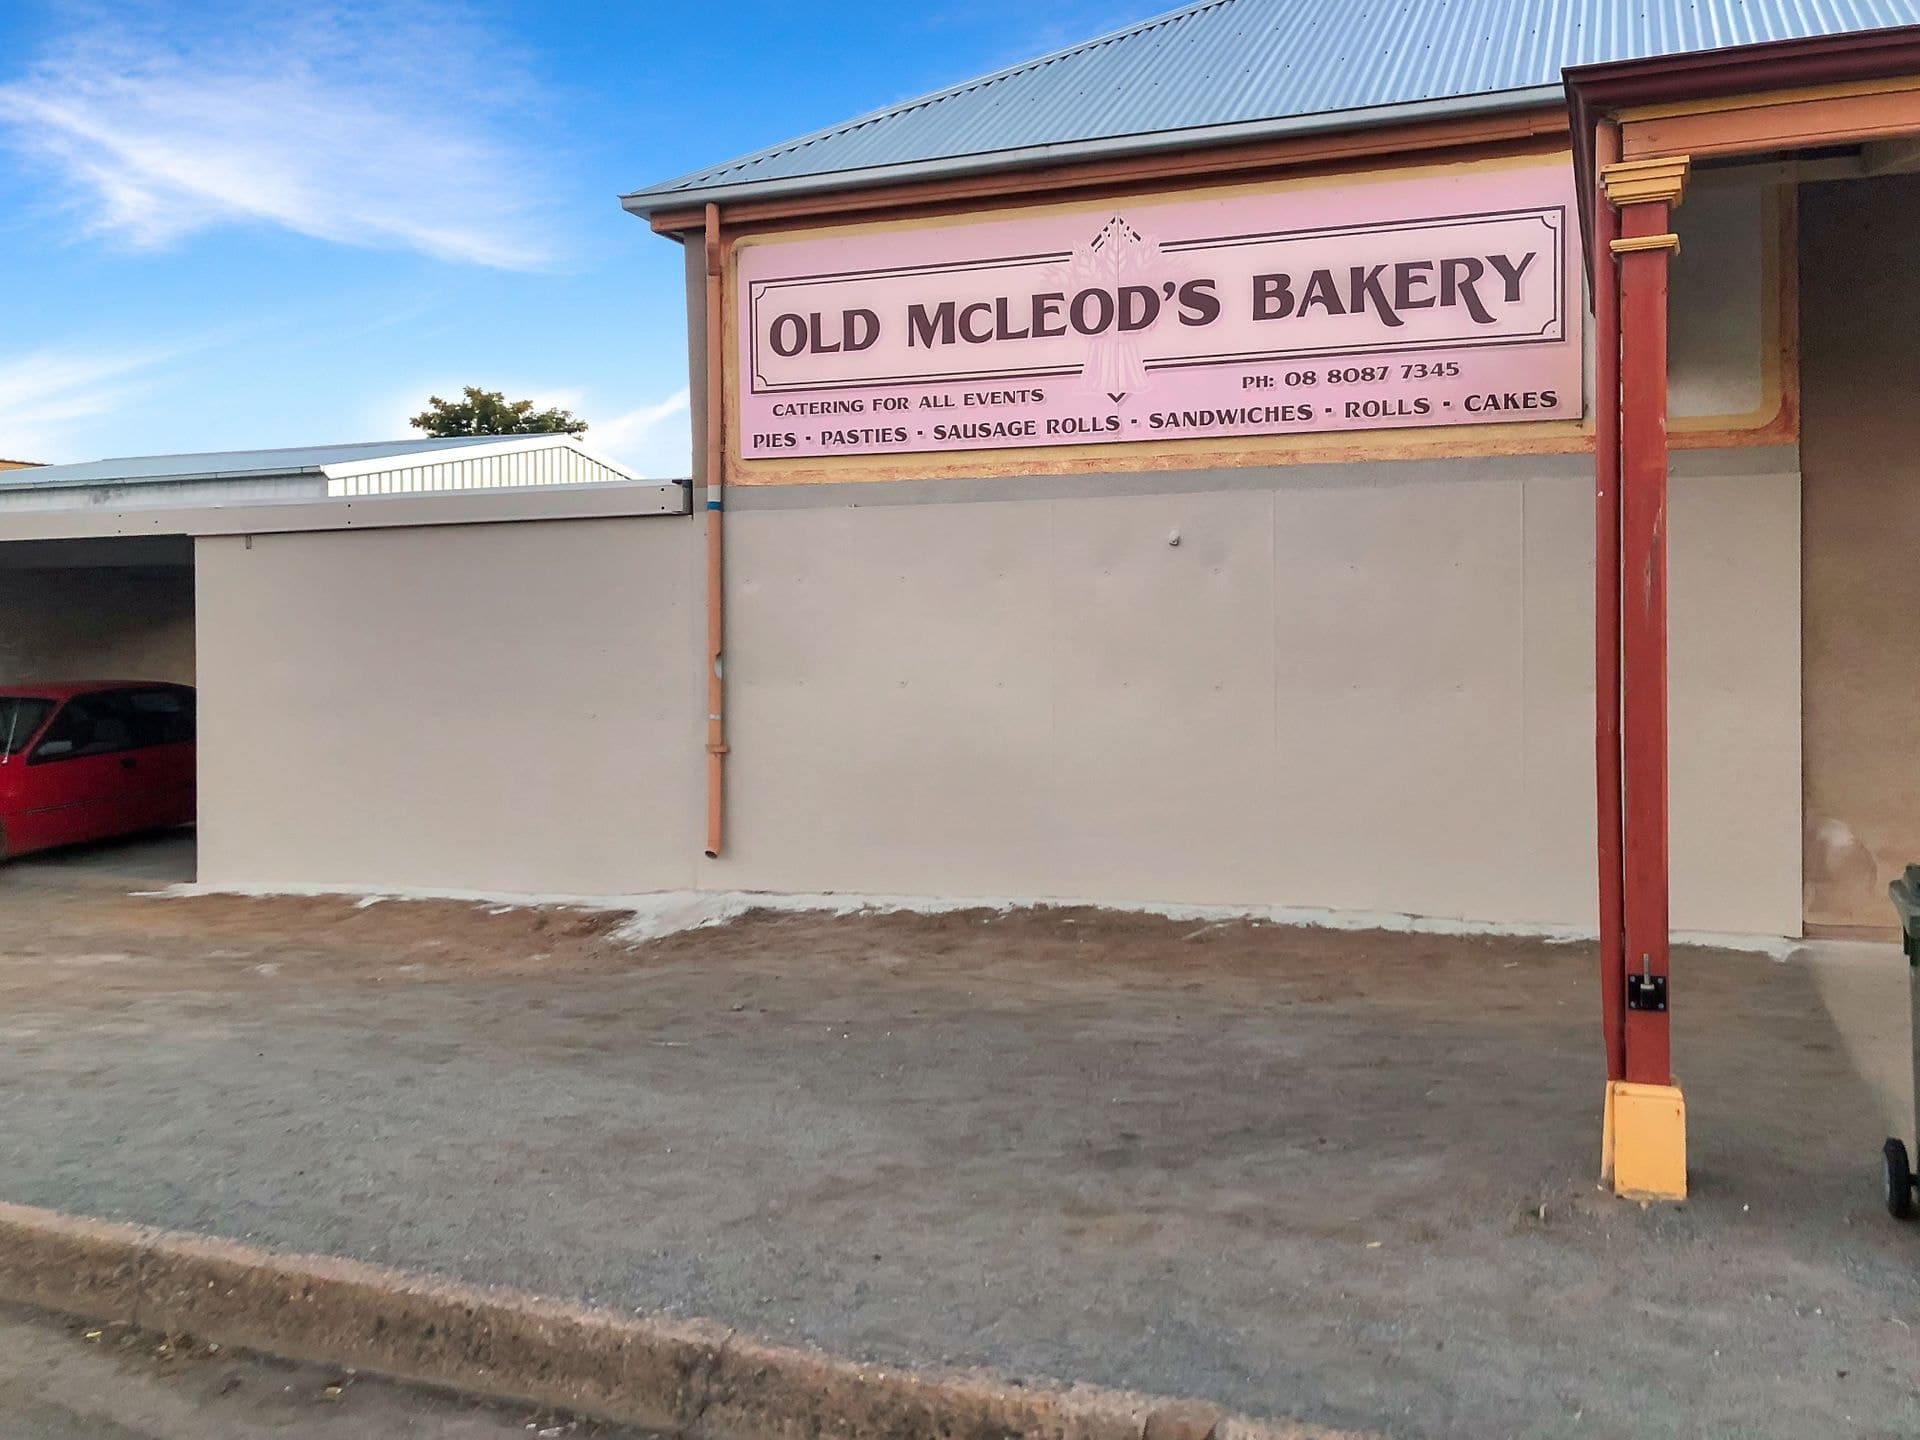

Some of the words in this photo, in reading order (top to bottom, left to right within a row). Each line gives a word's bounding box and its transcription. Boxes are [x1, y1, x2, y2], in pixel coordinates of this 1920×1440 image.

[769, 308, 881, 358] OLD
[907, 278, 1221, 349] MCLEOD'S
[1252, 251, 1537, 328] BAKERY
[1242, 375, 1275, 389] PH:
[1284, 370, 1317, 387] 08
[1326, 365, 1390, 384] 8087
[1400, 361, 1460, 380] 7345
[753, 432, 797, 449] PIES
[820, 426, 908, 446] PASTIES
[933, 420, 1037, 441] SAUSAGE
[1046, 415, 1121, 435] ROLLS
[1149, 403, 1314, 430] SANDWICHES
[1344, 397, 1431, 419] ROLLS
[1463, 390, 1558, 413] CAKES
[772, 399, 865, 417] CATERING
[872, 396, 910, 412] FOR
[918, 394, 956, 409] ALL
[963, 388, 1045, 407] EVENTS
